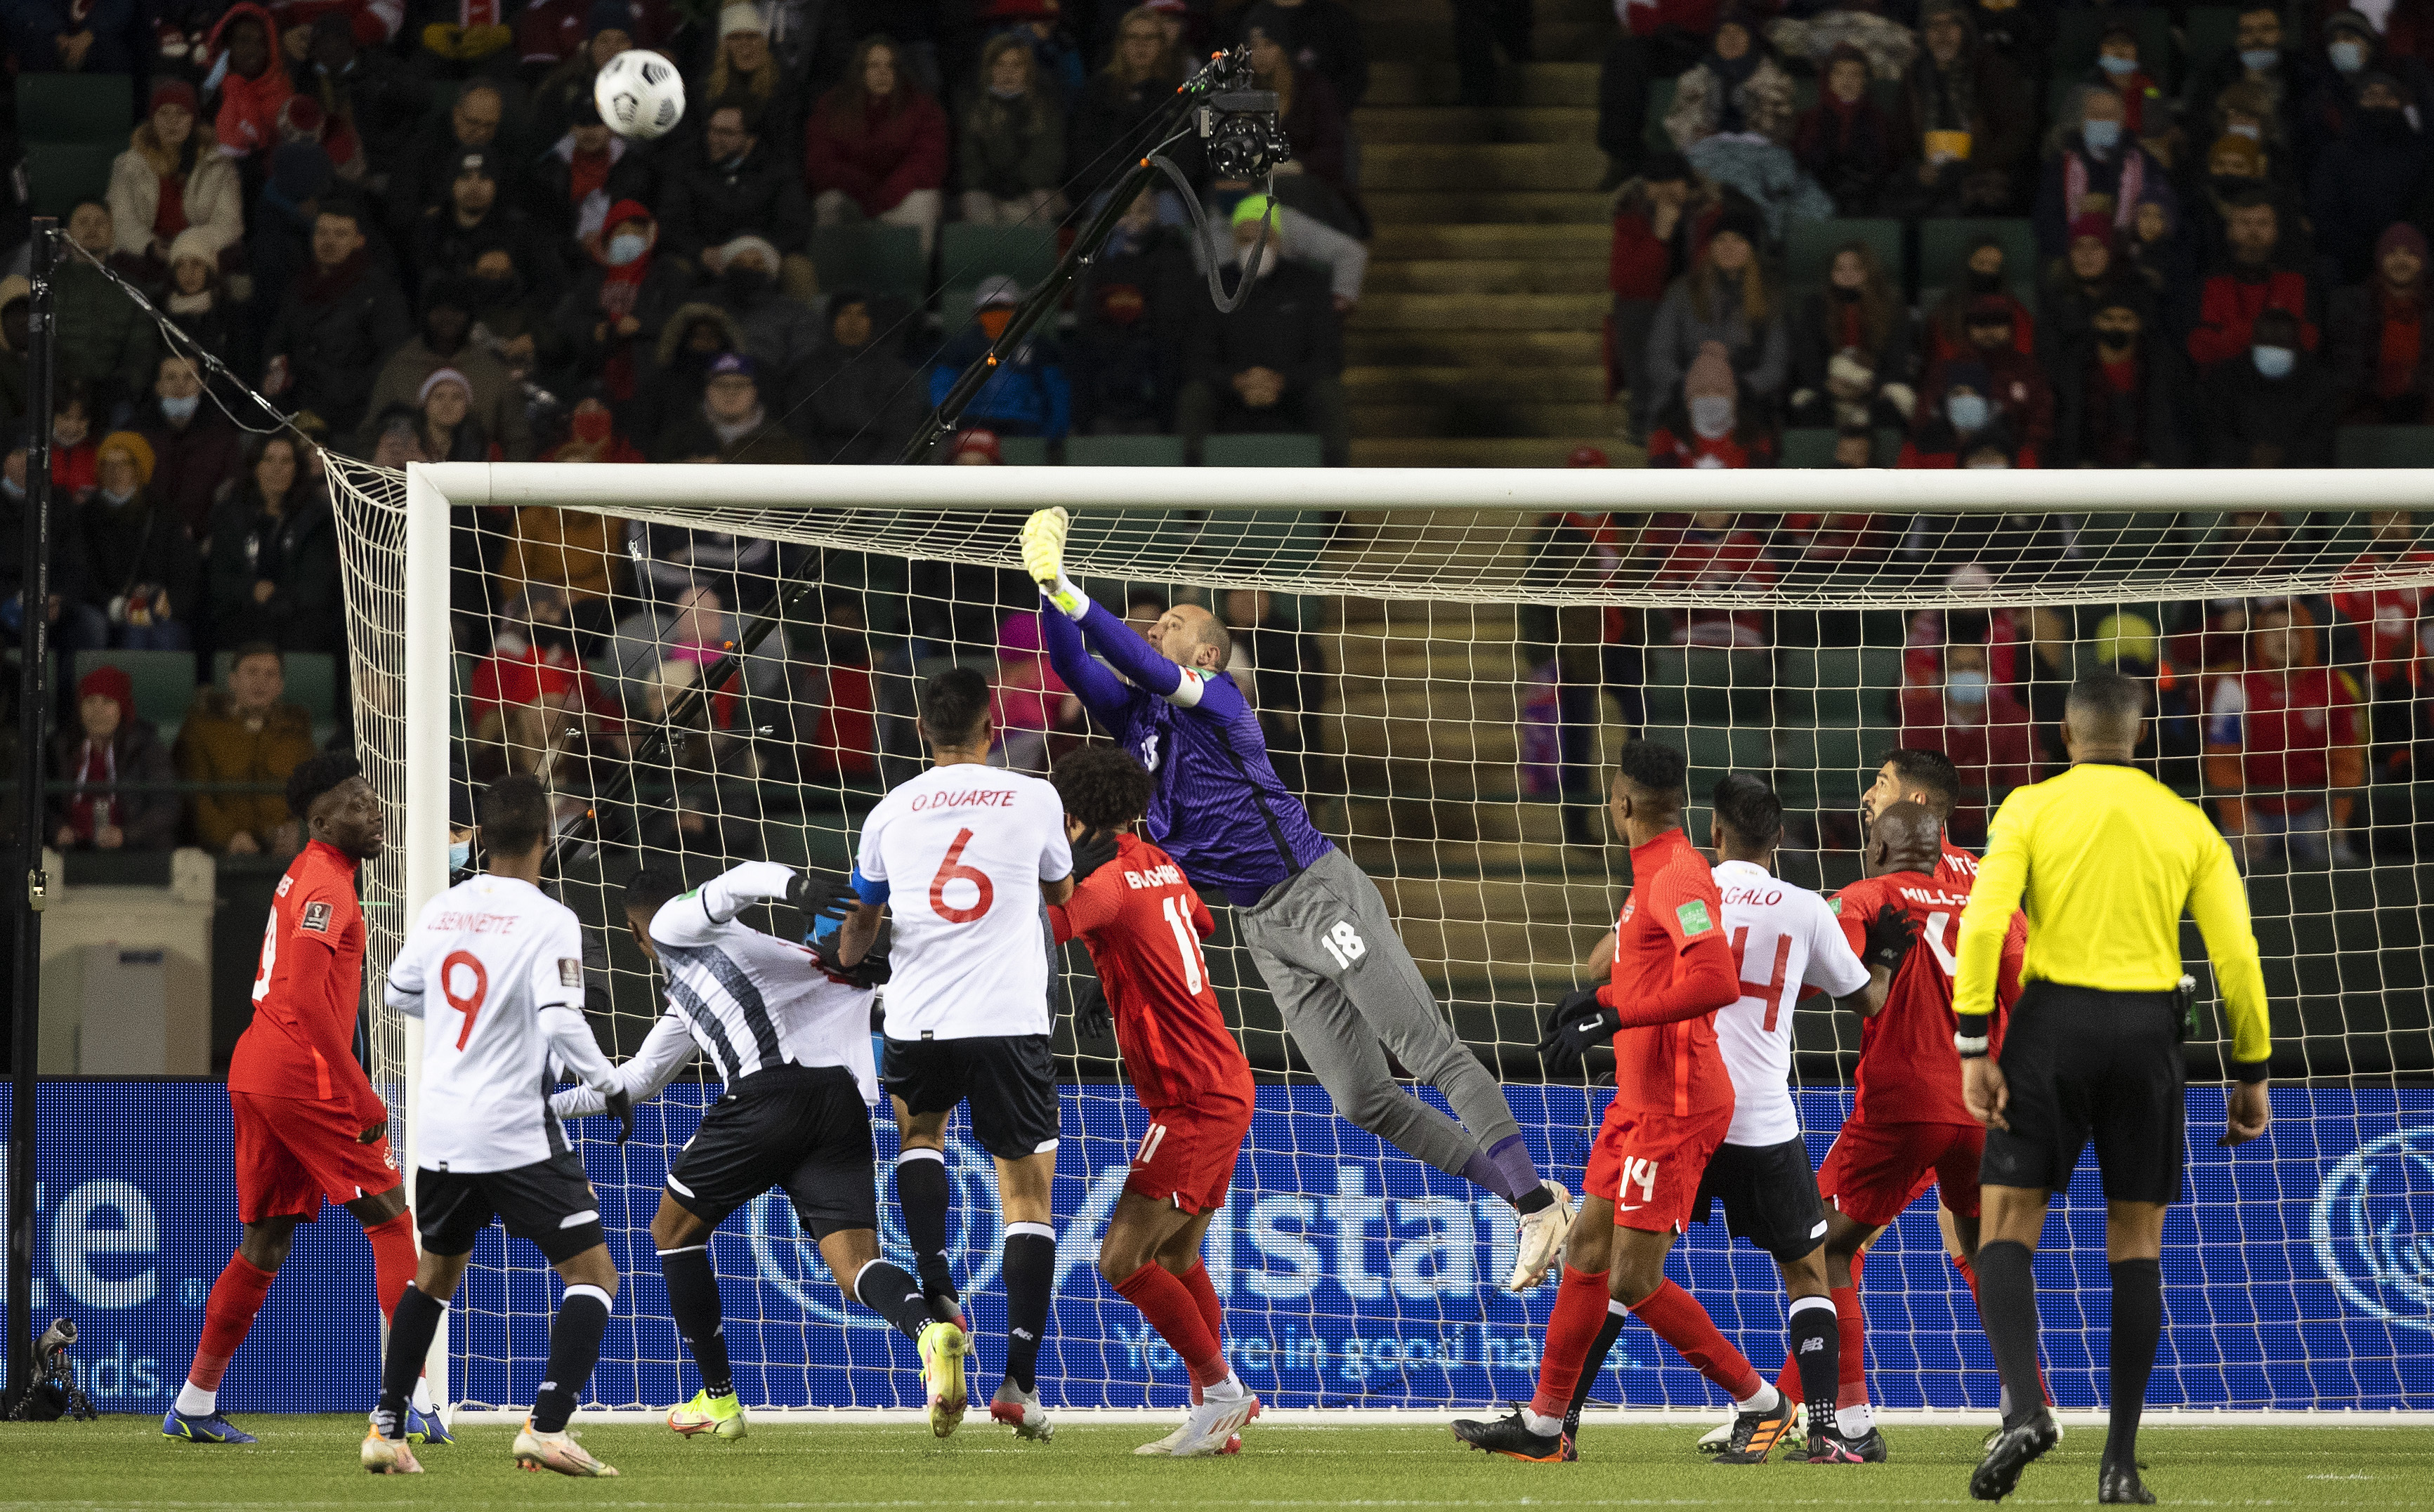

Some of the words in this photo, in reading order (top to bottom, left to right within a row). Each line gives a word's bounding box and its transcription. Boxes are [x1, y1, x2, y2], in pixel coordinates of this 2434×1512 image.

[912, 789, 1017, 811] O.DUARTE
[929, 827, 994, 923] 6
[1899, 886, 1971, 907] MILLE
[1321, 920, 1366, 970] 18
[441, 949, 488, 1052] 9
[1135, 1122, 1167, 1164] 11
[1619, 1155, 1659, 1202] 14
[1285, 1323, 1328, 1369] in
